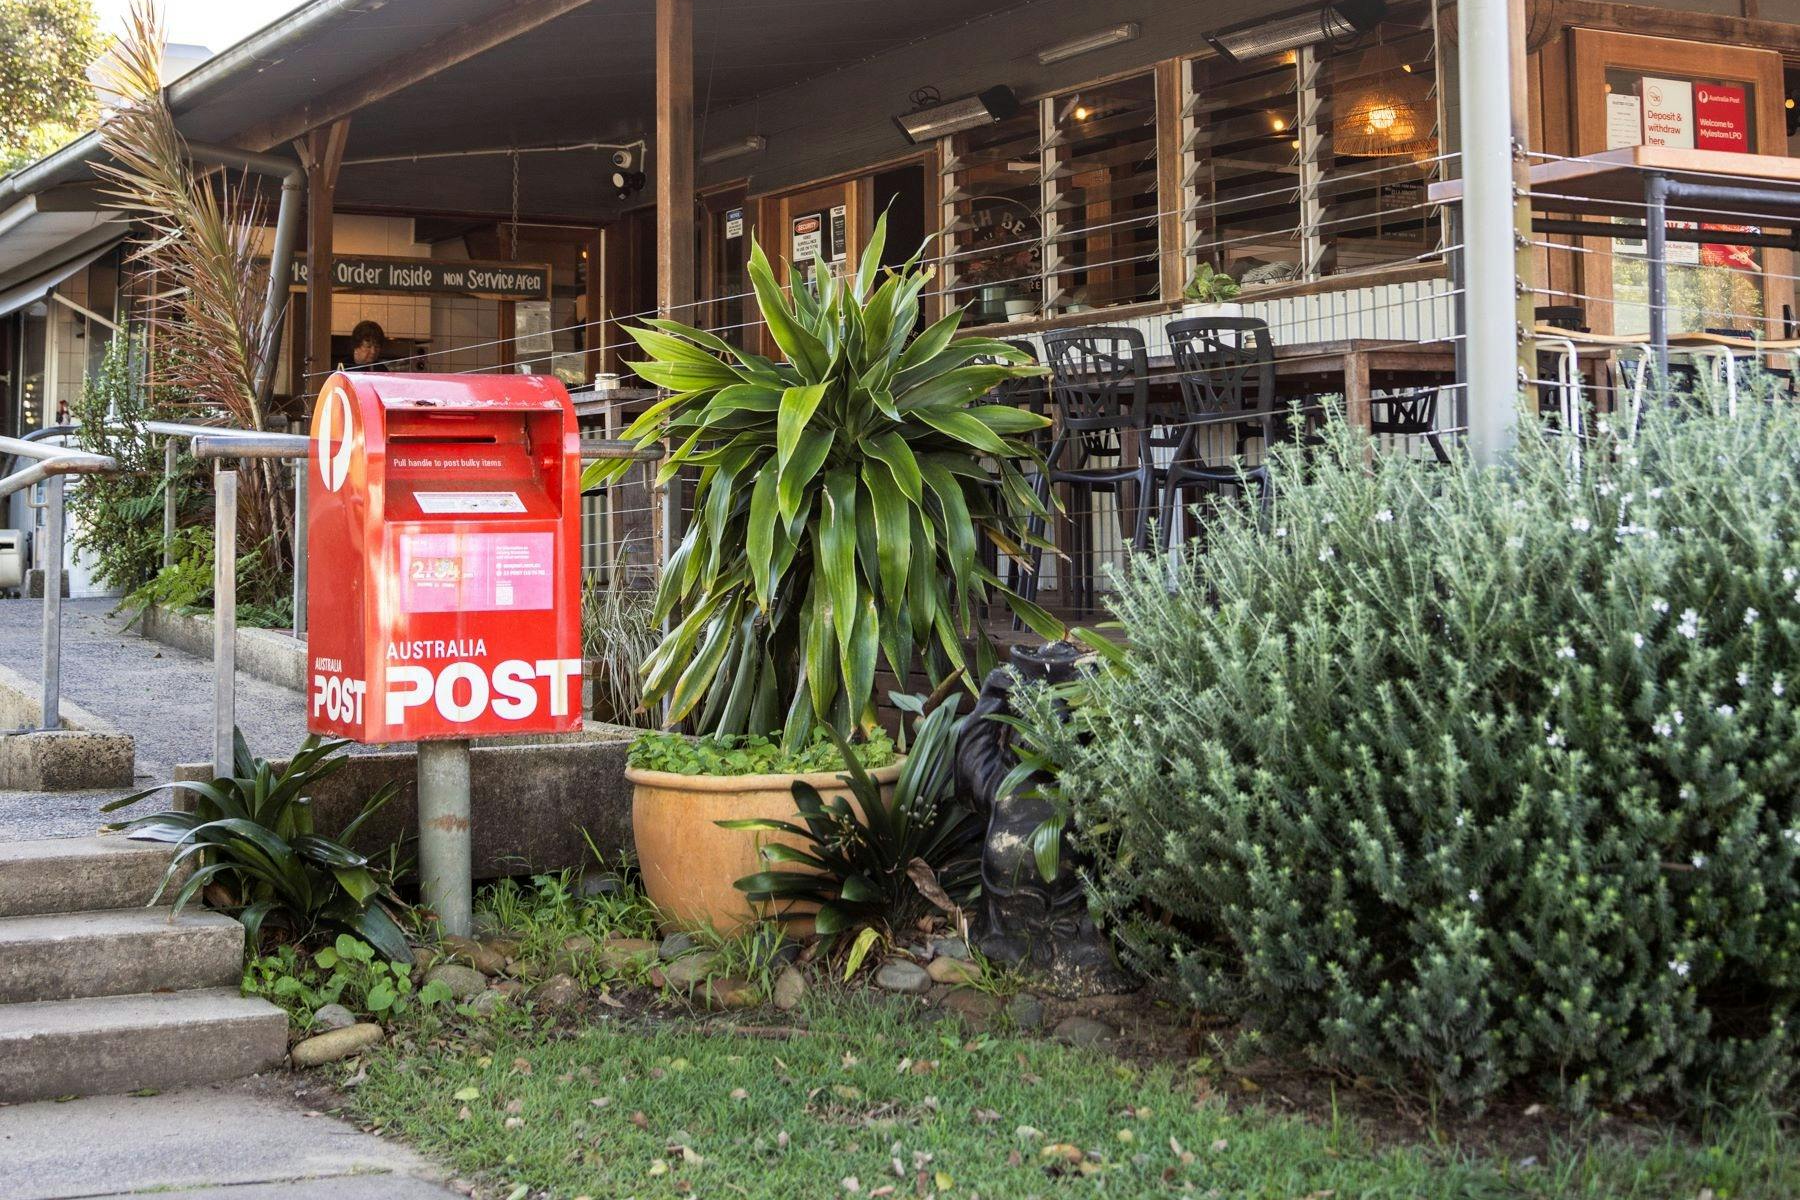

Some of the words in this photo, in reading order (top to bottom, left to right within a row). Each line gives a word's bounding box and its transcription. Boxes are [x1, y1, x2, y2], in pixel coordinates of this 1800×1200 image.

[1647, 110, 1676, 121] Deposit
[1676, 113, 1682, 122] &
[1647, 124, 1681, 134] withdraw
[1699, 118, 1727, 128] Welcome
[1727, 121, 1734, 129] to
[1648, 135, 1665, 146] here
[1729, 132, 1742, 140] LPO
[337, 262, 383, 284] Order
[389, 264, 432, 287] Inside
[443, 272, 464, 286] NON
[467, 268, 514, 290] Service
[514, 273, 541, 290] Area
[393, 458, 407, 467] Pull
[408, 458, 432, 467] handle
[434, 458, 442, 467] to
[443, 459, 460, 469] post
[461, 458, 480, 469] bulky
[482, 458, 502, 467] items
[386, 638, 488, 660] AUSTRALIA
[315, 656, 342, 673] AUSTRALIA
[385, 658, 582, 726] POST
[314, 674, 367, 725] POST
